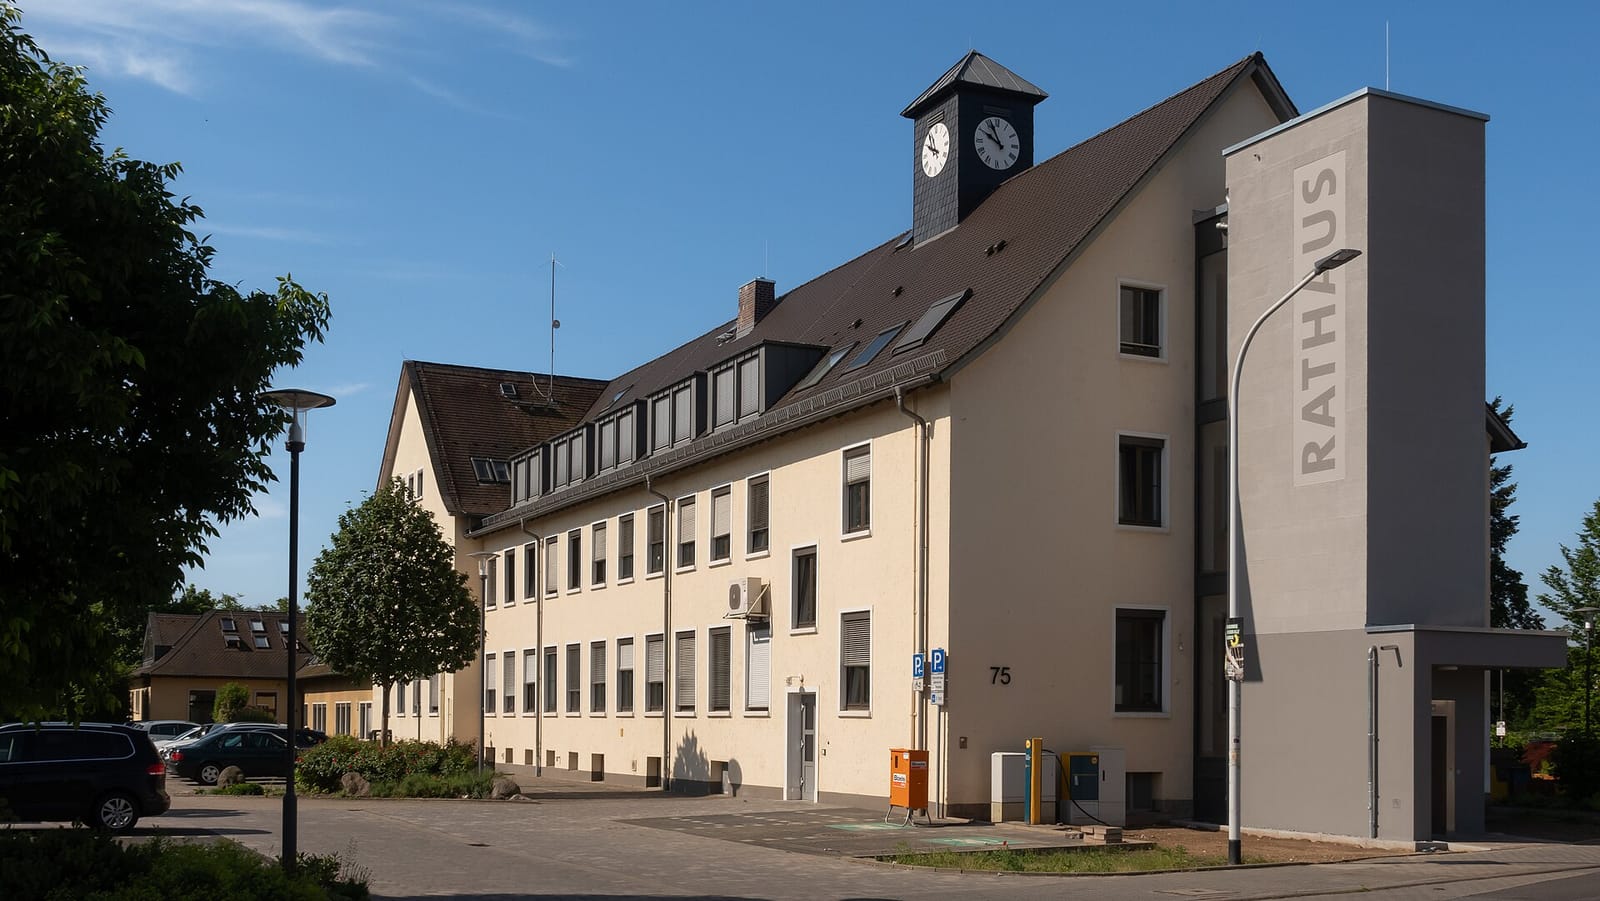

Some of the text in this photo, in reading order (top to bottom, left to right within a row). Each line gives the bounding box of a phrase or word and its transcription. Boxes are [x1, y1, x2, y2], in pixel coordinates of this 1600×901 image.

[1301, 167, 1337, 475] RATHAUS
[914, 656, 922, 675] P
[934, 652, 942, 671] P
[990, 666, 1011, 685] 75
